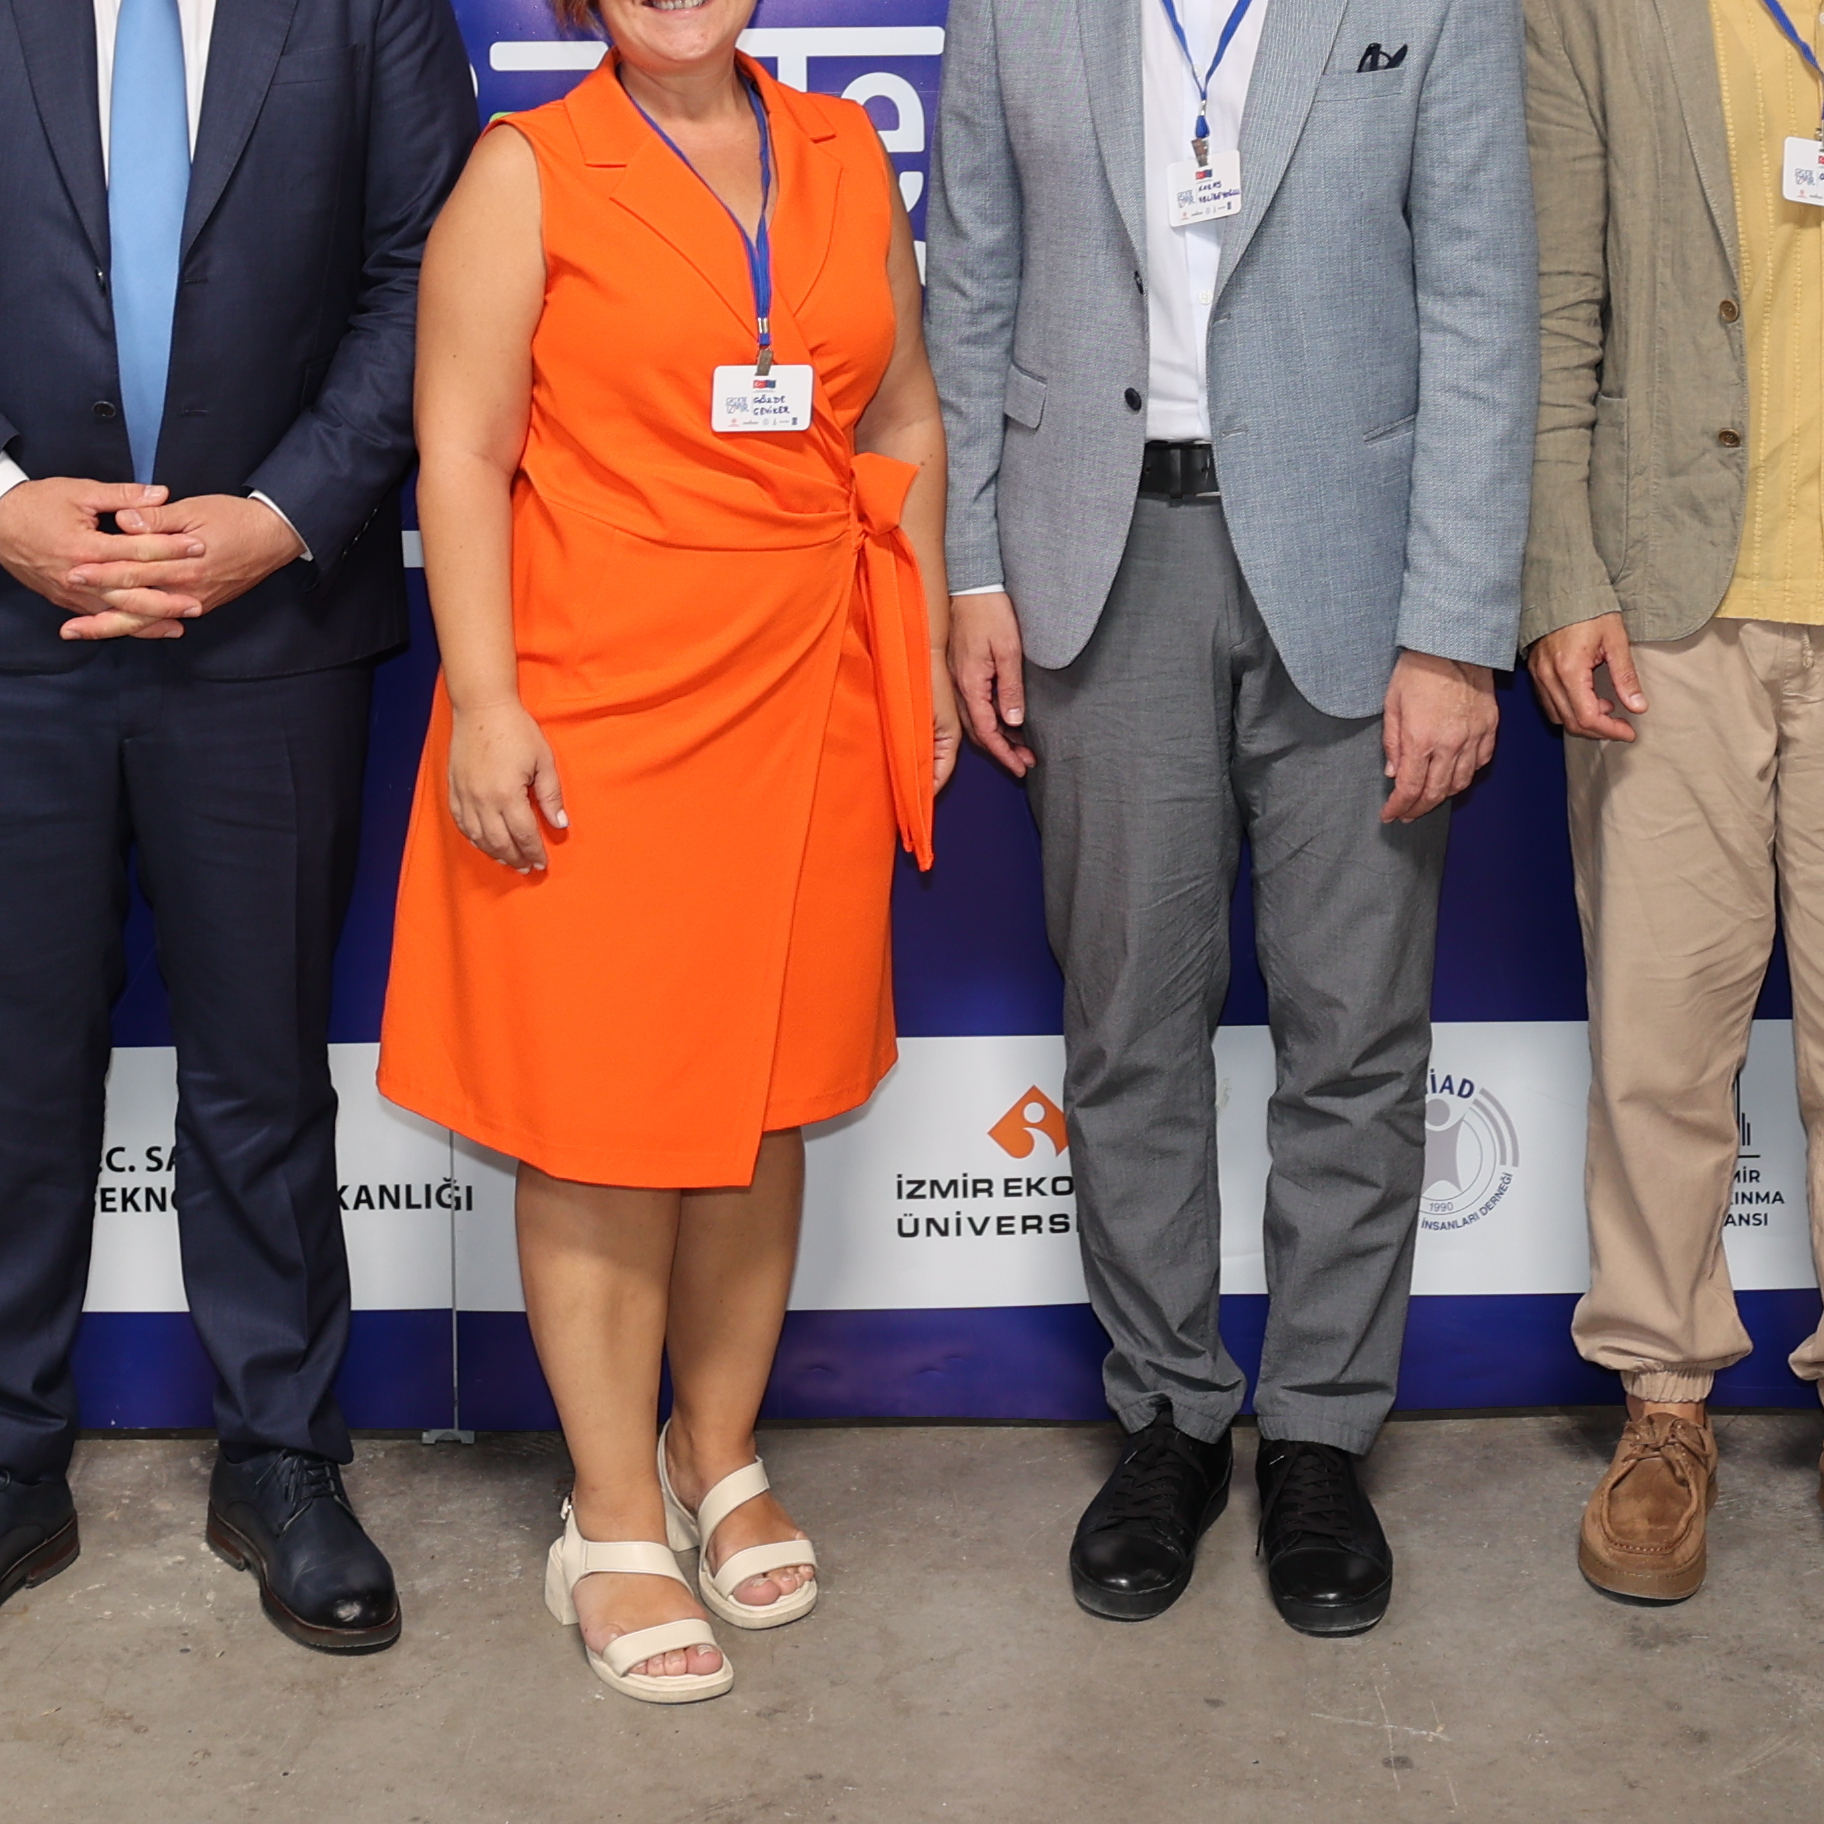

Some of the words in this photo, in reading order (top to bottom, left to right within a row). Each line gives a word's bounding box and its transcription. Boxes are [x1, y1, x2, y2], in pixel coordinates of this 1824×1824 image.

[897, 1172, 994, 1199] İZMİR
[1003, 1175, 1075, 1198] EKO
[1421, 1211, 1480, 1231] İNSANLARI
[1480, 1172, 1513, 1217] DERNEĞİ
[1429, 1201, 1454, 1212] 1990
